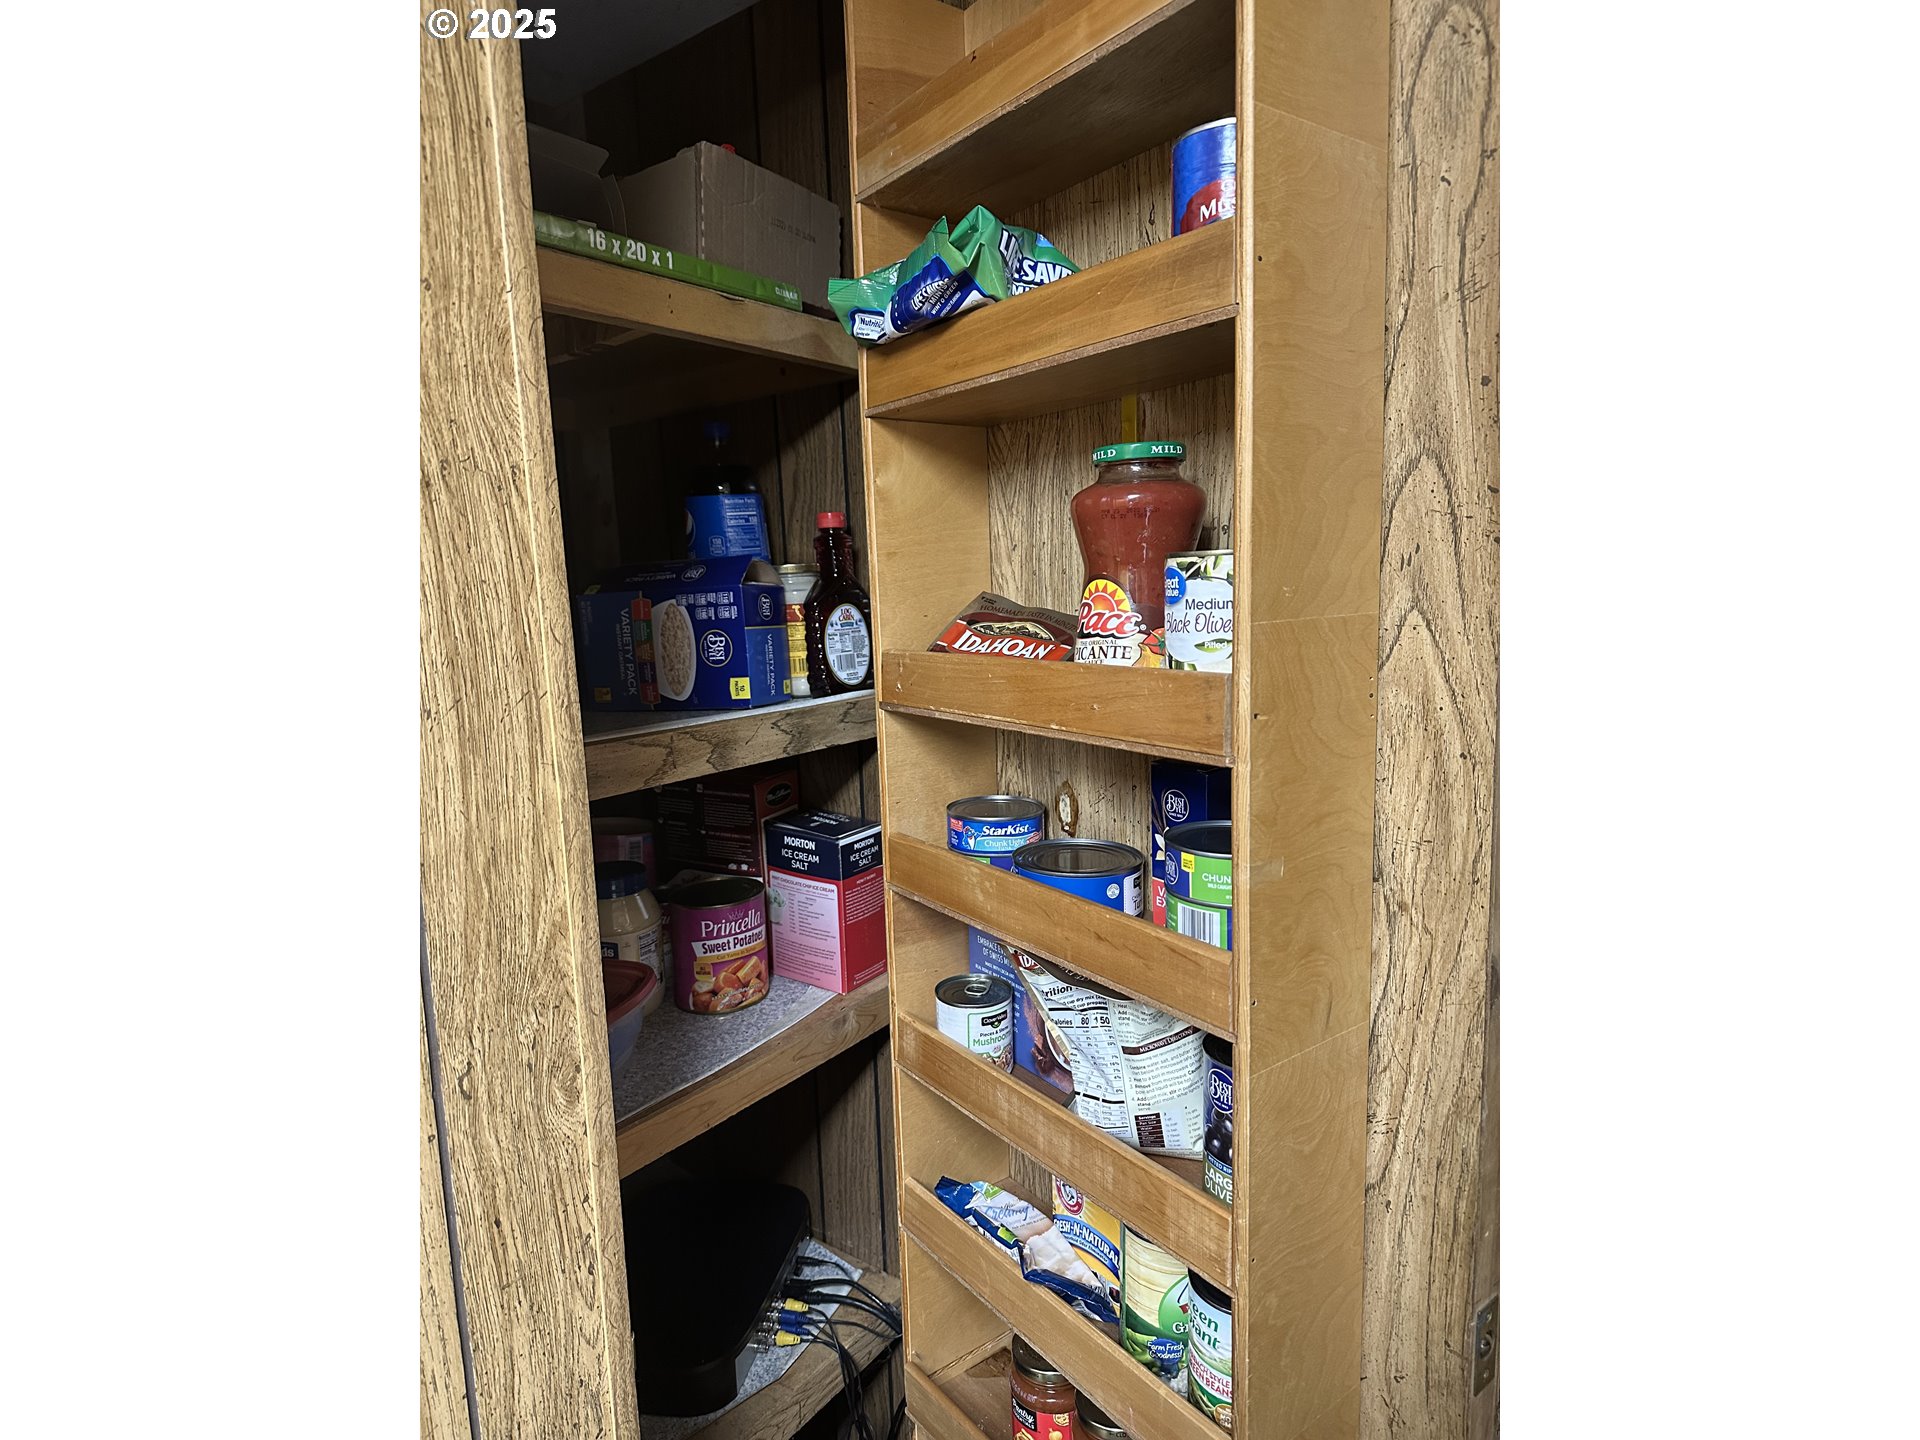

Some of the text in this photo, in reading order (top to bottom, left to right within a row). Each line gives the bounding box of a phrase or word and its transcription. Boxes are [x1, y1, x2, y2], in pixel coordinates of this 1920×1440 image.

[588, 228, 673, 270] 16 x 20 x 1
[943, 281, 959, 299] GREEN
[1151, 445, 1183, 454] MILD
[1077, 600, 1143, 637] Pace
[620, 608, 638, 695] VARIETY PACK
[767, 634, 775, 670] VARIETY
[952, 629, 1055, 660] IDAHOAN
[1204, 641, 1228, 650] Pitted
[1166, 794, 1184, 812] BEST
[982, 823, 1029, 836] StarKist
[784, 836, 816, 851] MORTON
[854, 837, 875, 851] MORTON
[984, 839, 1008, 848] Chunk
[781, 848, 820, 864] ICE CREAM
[850, 845, 879, 862] ICE CREAM
[858, 856, 872, 867] SALT
[791, 859, 809, 871] SALT
[780, 877, 802, 887] CHOCOLATE
[820, 886, 835, 894] CREAM
[701, 909, 761, 938] Princella
[702, 930, 764, 955] Sweet Potatoes
[977, 935, 999, 952] EMBRACE
[983, 947, 1004, 964] OF SWISS
[1081, 1016, 1090, 1025] 80
[979, 1029, 995, 1037] Pieces
[1139, 1038, 1168, 1053] MICROWAVE
[1155, 1083, 1168, 1091] liquid
[1210, 1073, 1232, 1099] BEST
[1208, 1155, 1223, 1169] PITTED
[1148, 1341, 1185, 1352] Farm Fresh
[1149, 1350, 1183, 1359] Goodness!
[1210, 1371, 1230, 1389] STYLE
[1012, 1398, 1035, 1423] Pantry
